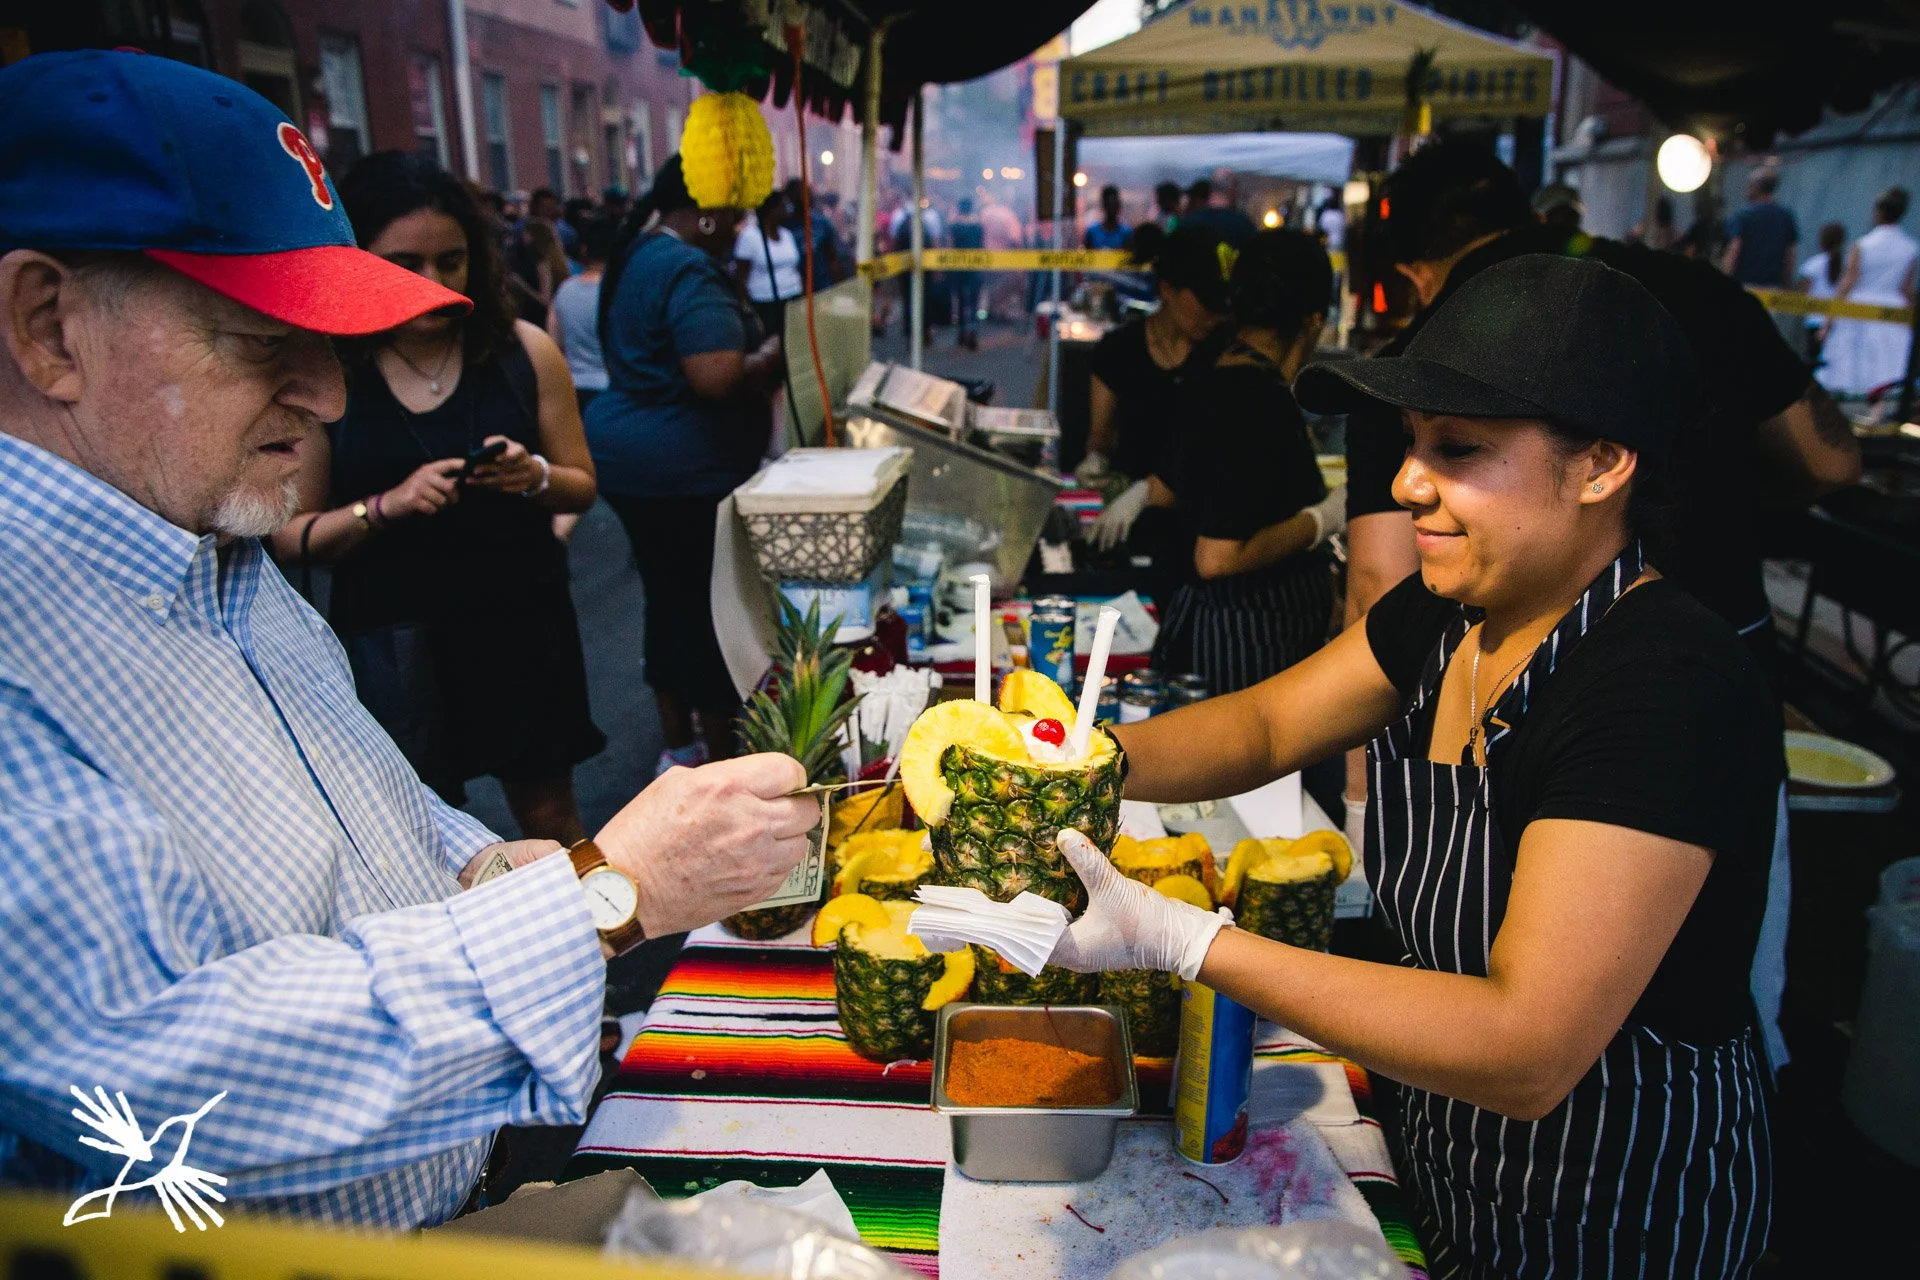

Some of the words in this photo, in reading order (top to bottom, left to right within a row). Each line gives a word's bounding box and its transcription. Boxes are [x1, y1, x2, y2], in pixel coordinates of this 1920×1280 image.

[1071, 69, 1169, 102] CRAFT
[1203, 66, 1373, 101] DISTILLED
[1411, 66, 1538, 103] PIRITS
[276, 121, 334, 211] P
